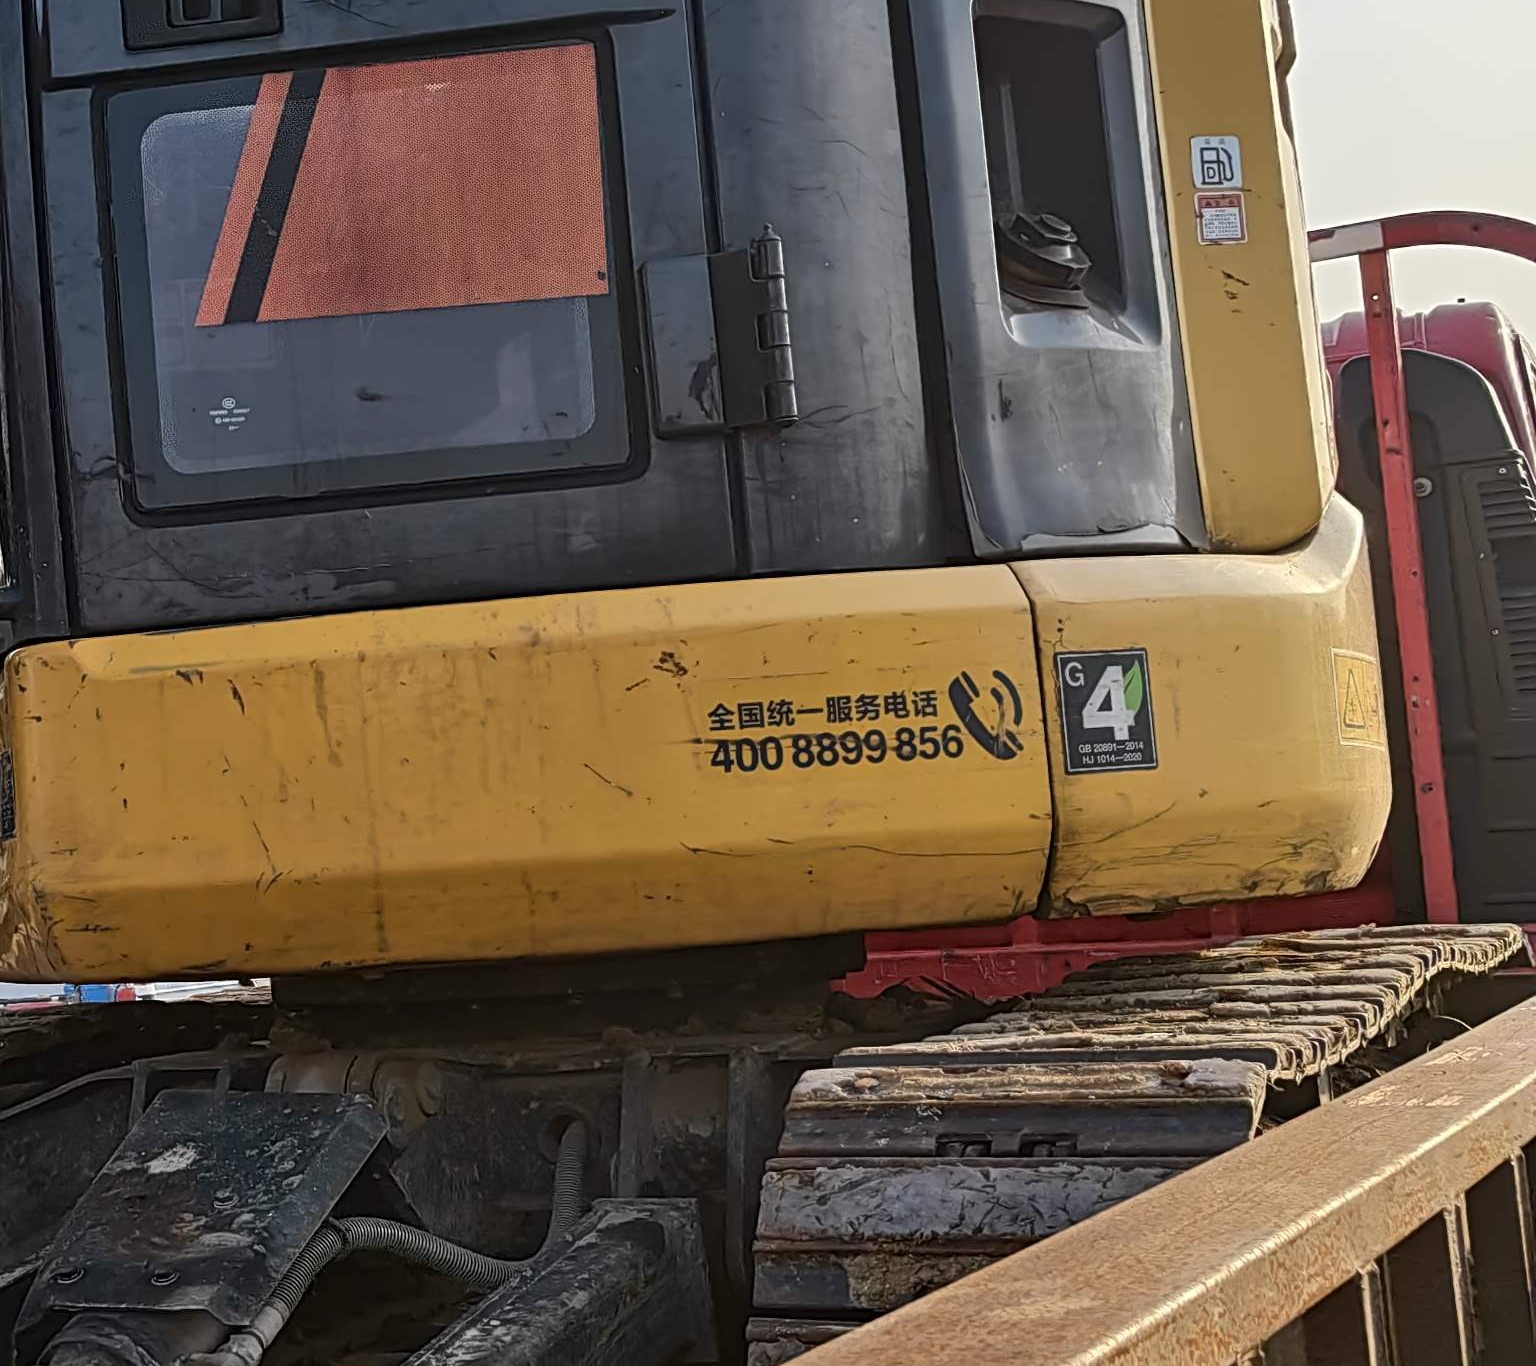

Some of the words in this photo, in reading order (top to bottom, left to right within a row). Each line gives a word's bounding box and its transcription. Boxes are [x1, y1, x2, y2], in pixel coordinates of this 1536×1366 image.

[1064, 661, 1085, 687] G
[707, 690, 939, 731] 全国统一服务电话
[1082, 665, 1136, 741] 4
[710, 736, 784, 773] 400
[791, 729, 888, 769] 8899
[895, 724, 965, 762] 856
[1078, 744, 1092, 754] GB
[1082, 755, 1095, 765] HJ
